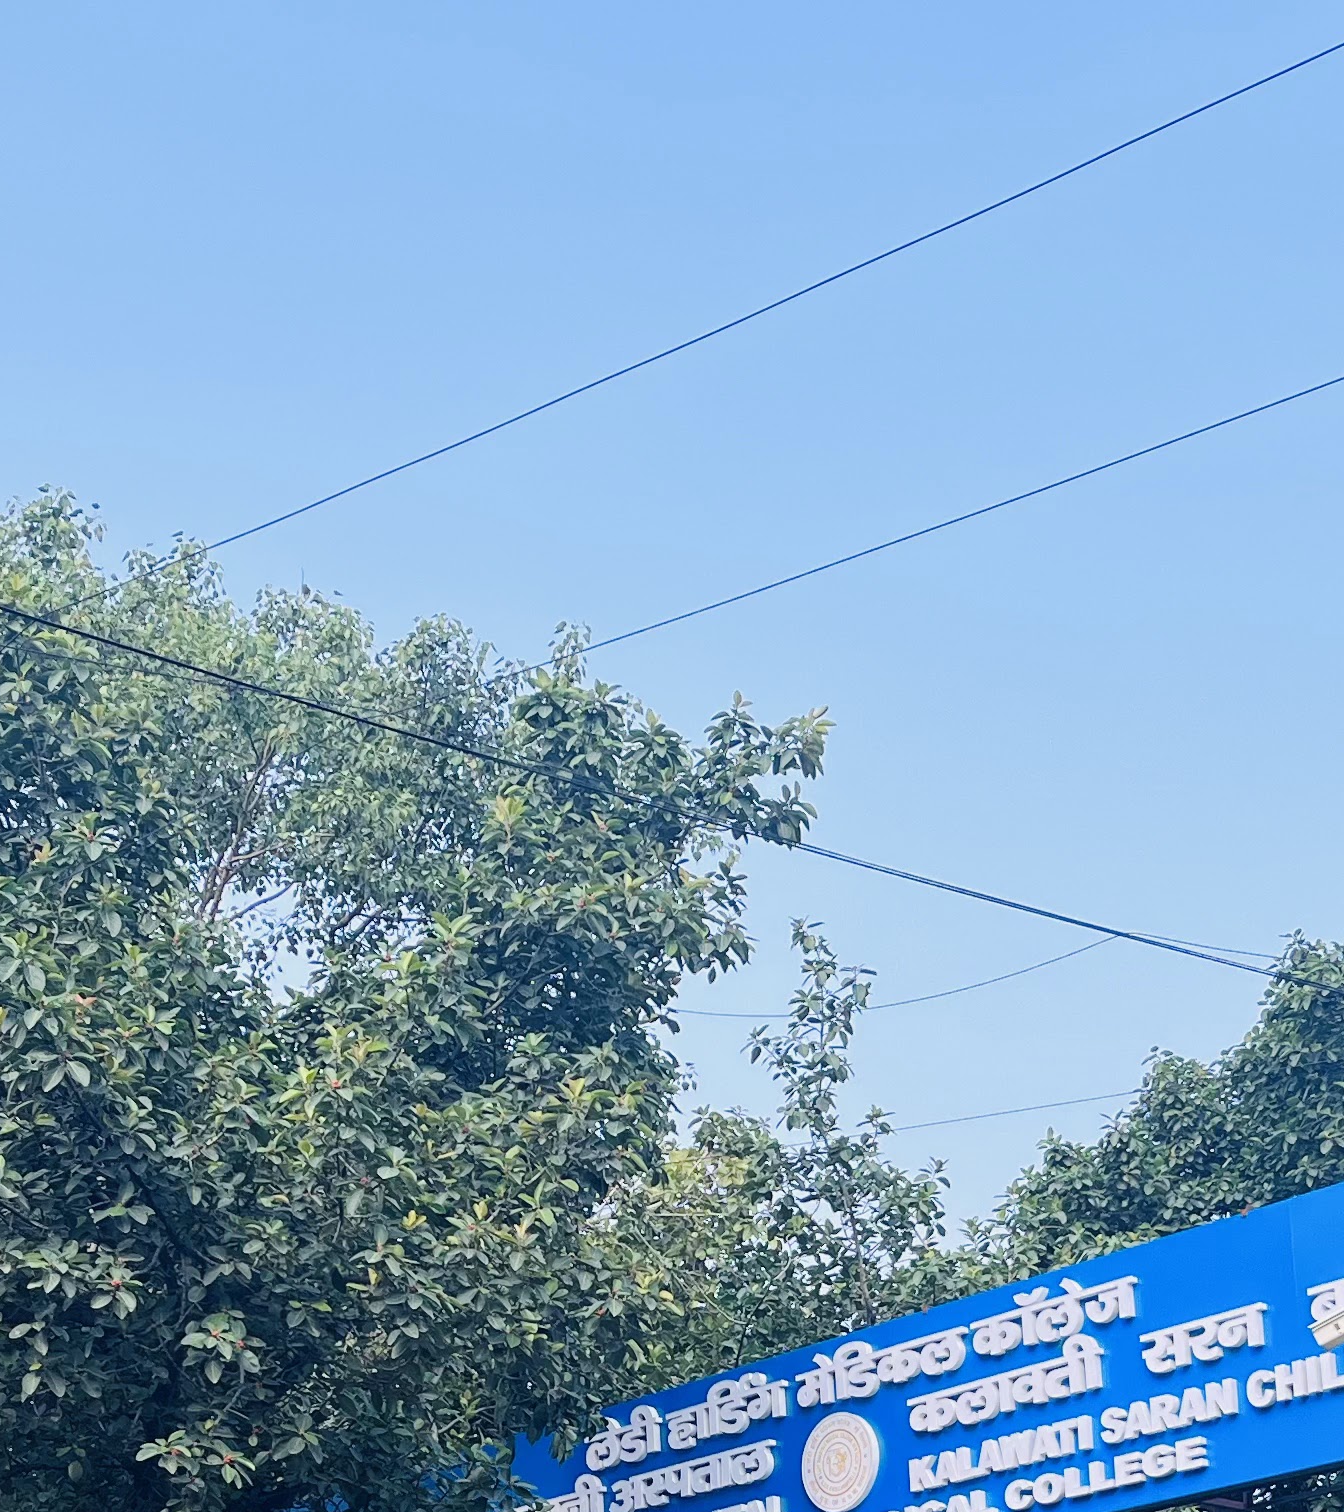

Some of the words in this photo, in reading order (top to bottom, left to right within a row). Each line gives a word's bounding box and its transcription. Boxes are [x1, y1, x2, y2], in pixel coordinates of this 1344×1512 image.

[584, 1406, 663, 1471] लेडी
[795, 1326, 968, 1408] मेडिकल
[971, 1275, 1139, 1356] कॉलेज
[907, 1334, 1105, 1432] कलावती
[1140, 1302, 1268, 1374] सरन
[908, 1414, 1093, 1493] KALAWATI
[1100, 1378, 1240, 1445] SARAN
[1005, 1435, 1209, 1511] COLLEGE
